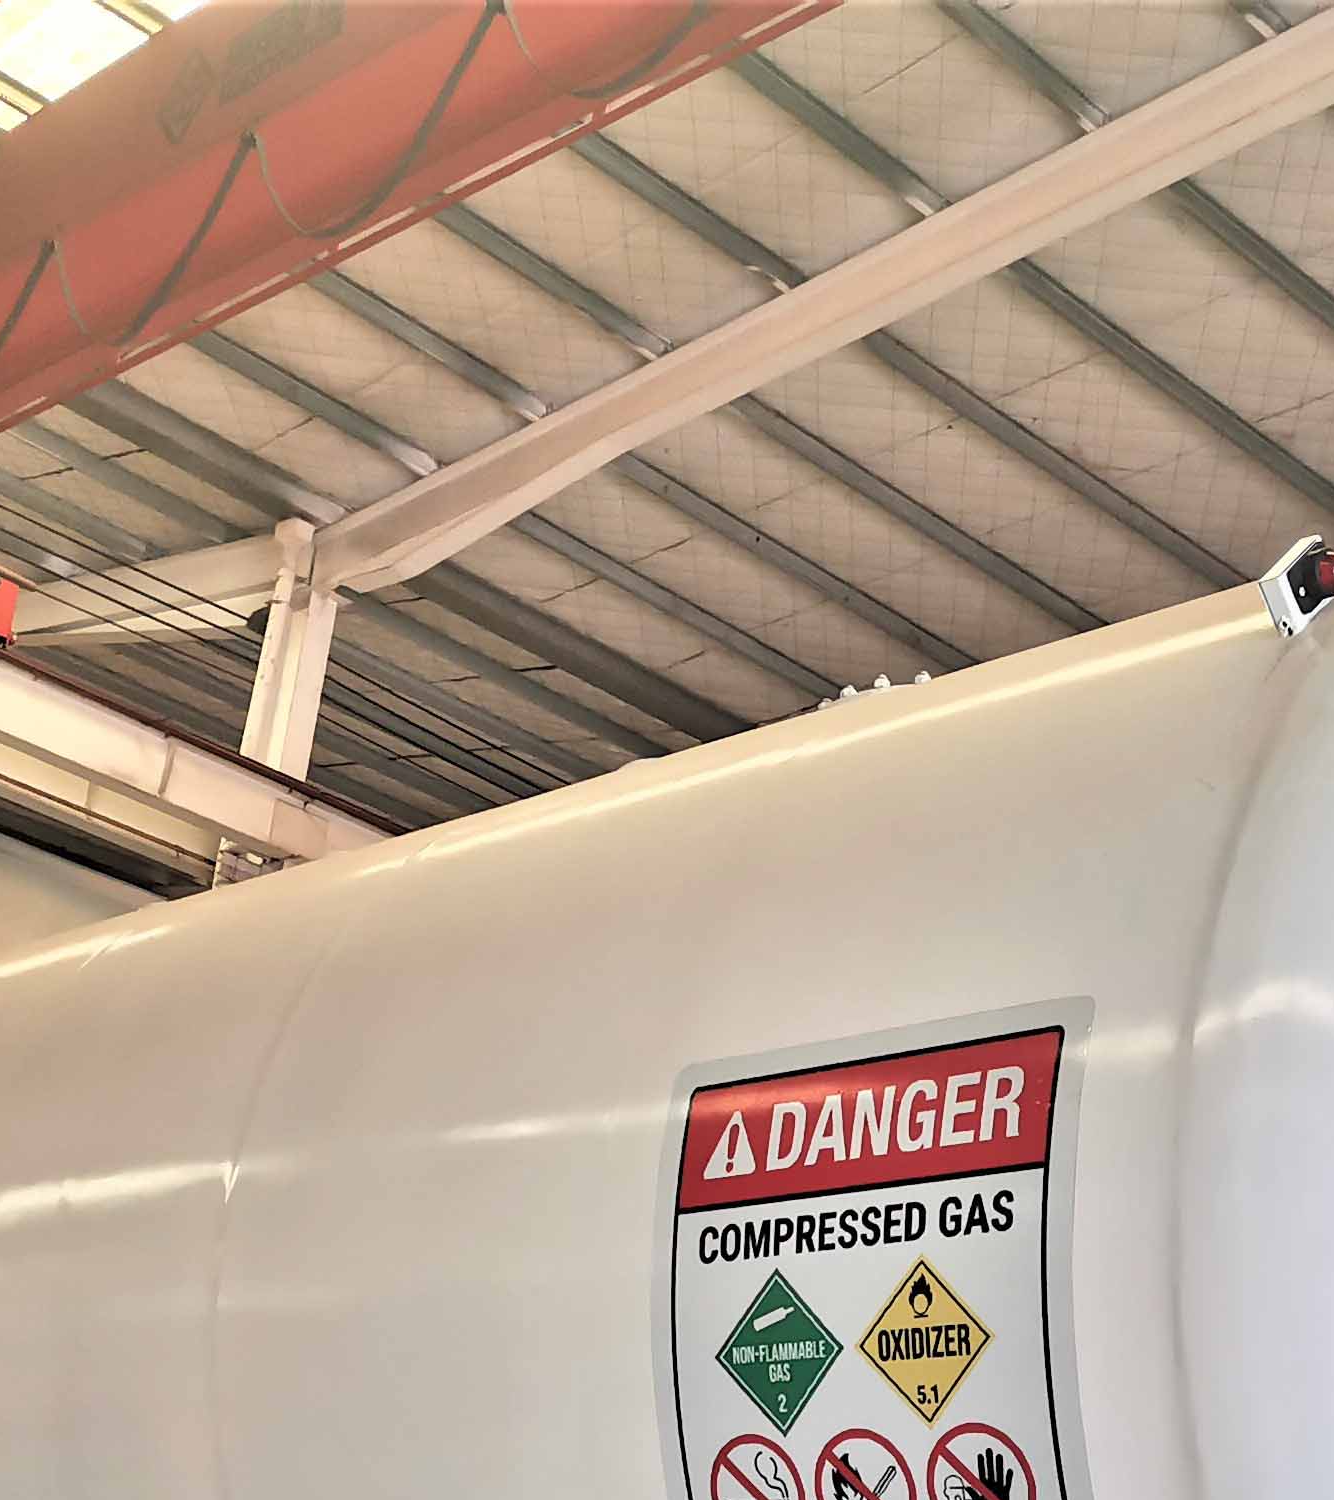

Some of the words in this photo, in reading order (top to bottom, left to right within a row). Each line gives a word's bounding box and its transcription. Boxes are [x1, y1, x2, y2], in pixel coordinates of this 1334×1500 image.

[765, 1066, 1024, 1172] DANGER
[699, 1202, 926, 1264] COMPRESSED
[939, 1190, 1014, 1238] GAS
[732, 1341, 827, 1365] NON-FLAMMABLE
[877, 1323, 971, 1363] OXIDIZER
[768, 1363, 792, 1383] GAS
[777, 1394, 788, 1413] 2
[917, 1384, 940, 1405] 5.1
